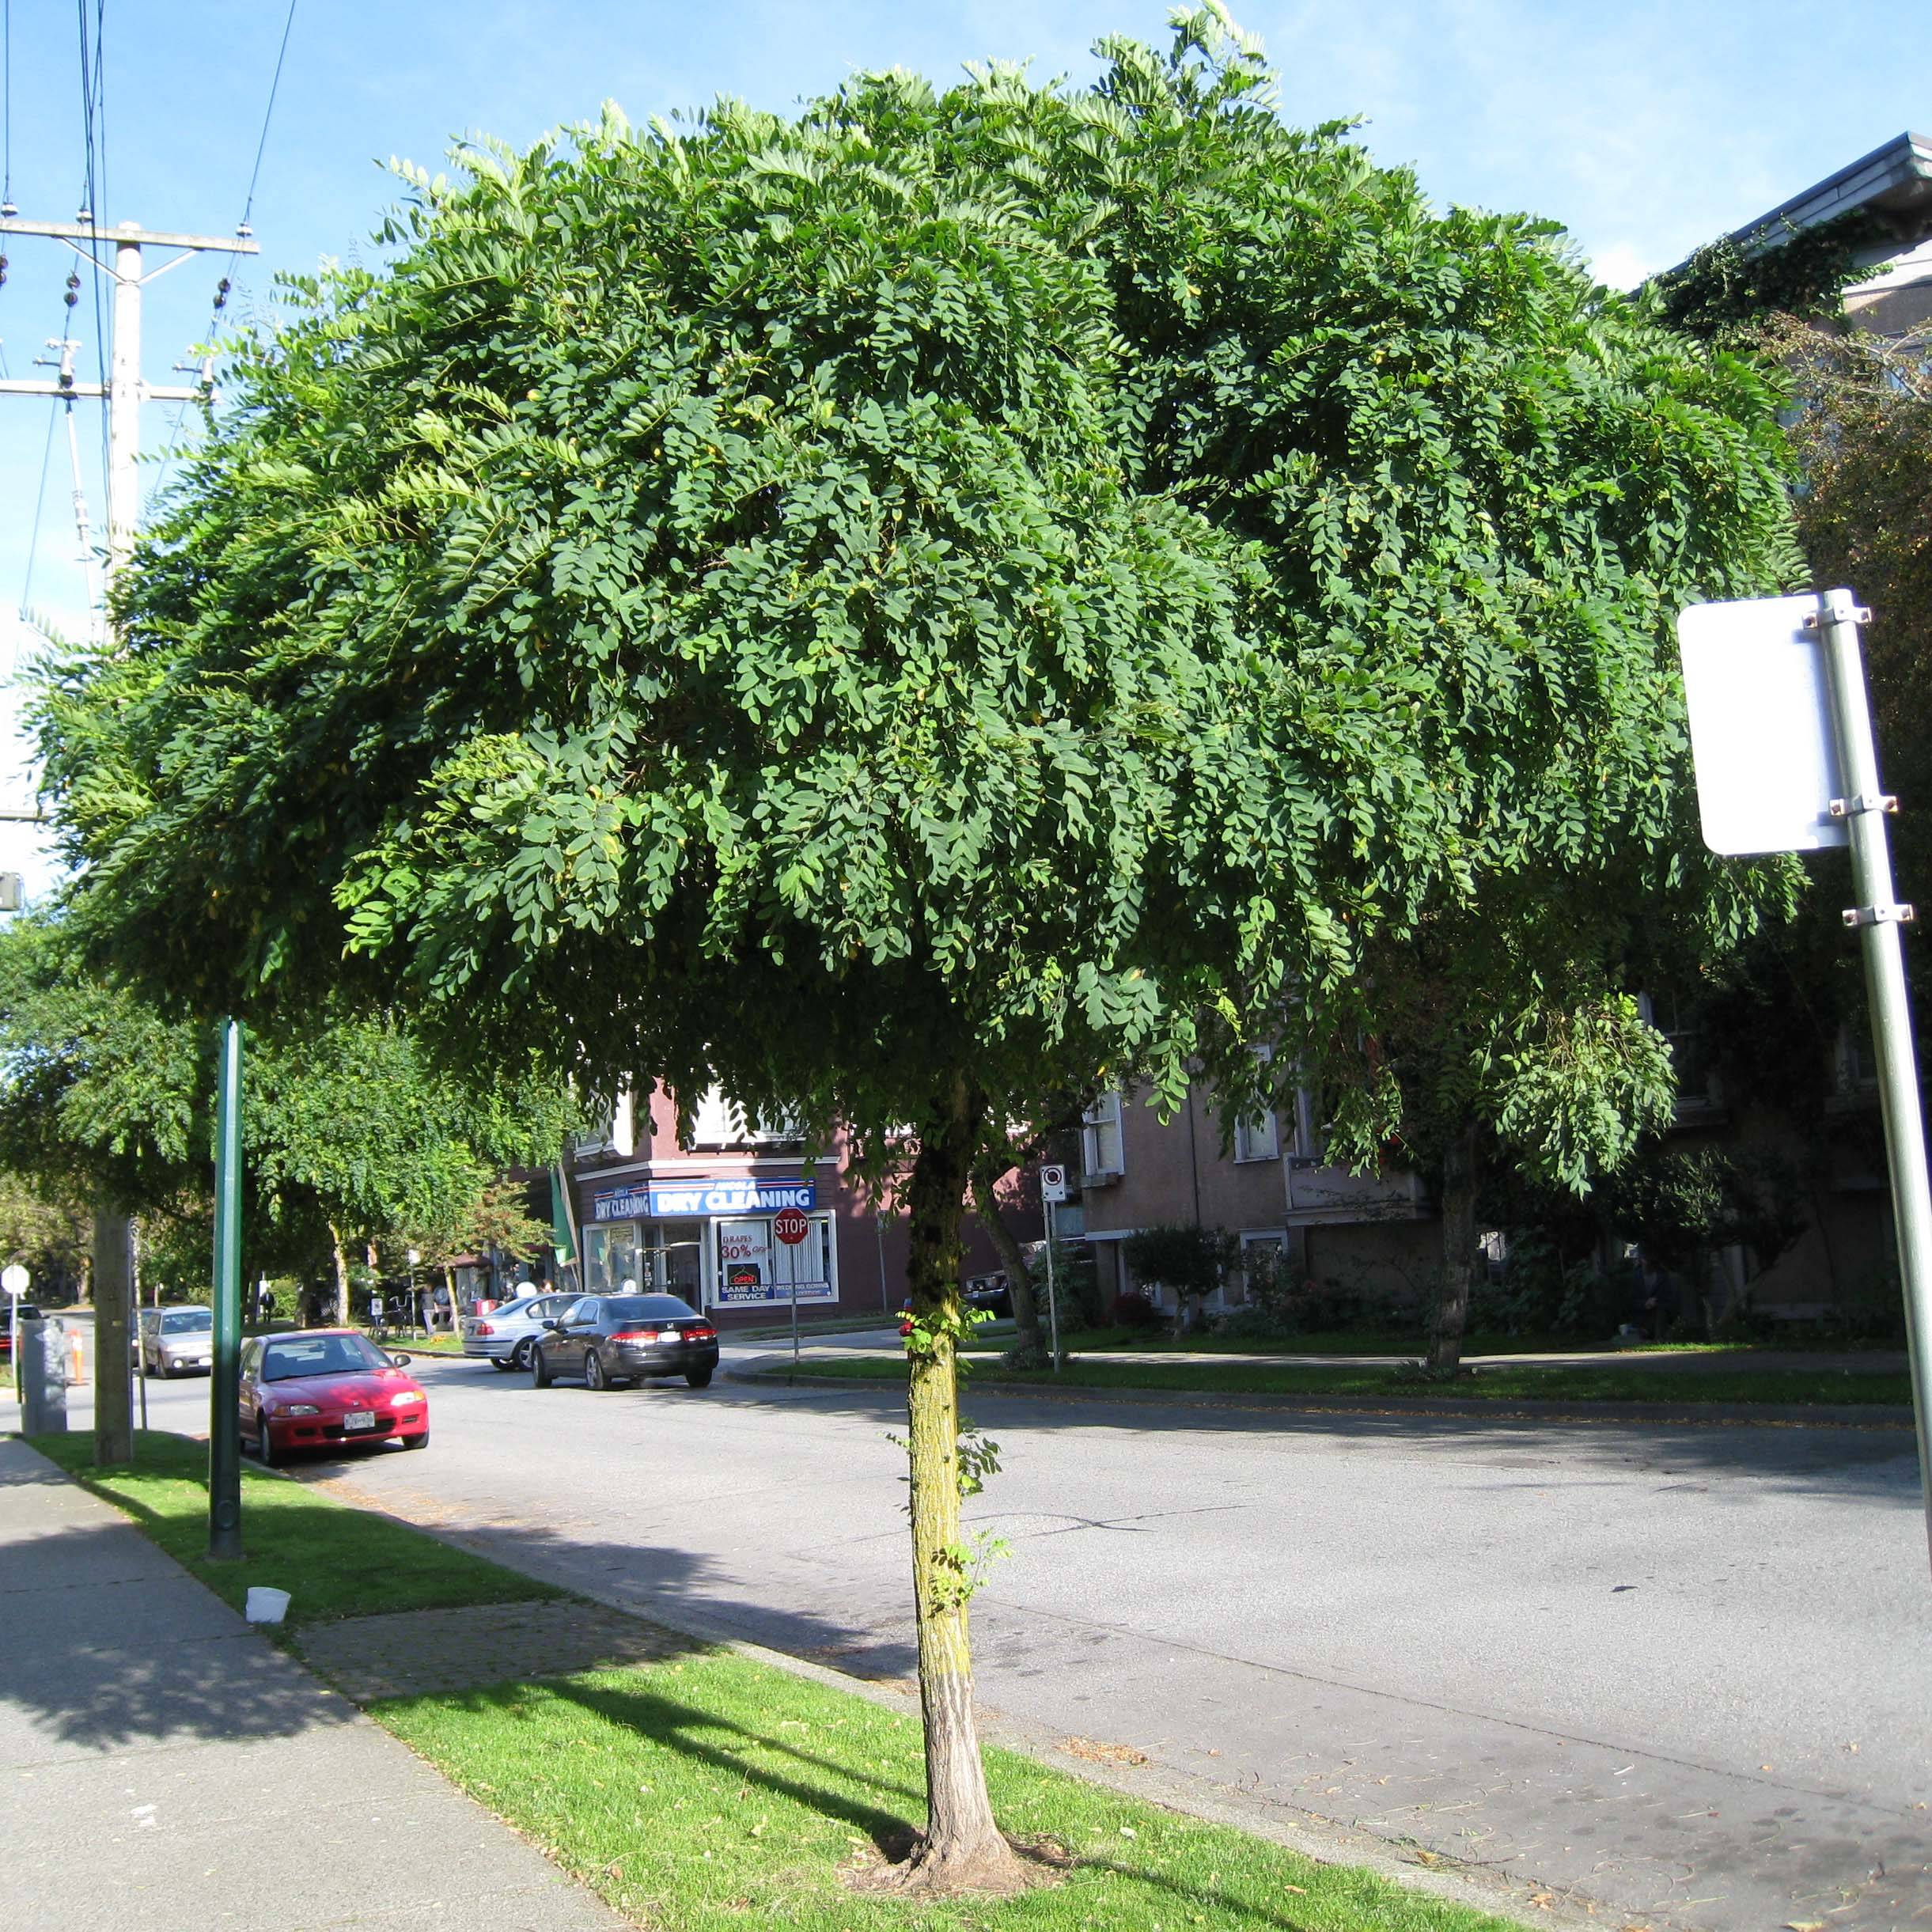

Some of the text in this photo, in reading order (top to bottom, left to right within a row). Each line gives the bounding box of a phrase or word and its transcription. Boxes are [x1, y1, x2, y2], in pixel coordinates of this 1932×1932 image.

[596, 1195, 649, 1219] DRY CLEANING
[657, 1188, 810, 1213] DRY CLEANING
[775, 1218, 806, 1234] STOP
[722, 1244, 751, 1259] 30%
[727, 1292, 767, 1301] SERVICE
